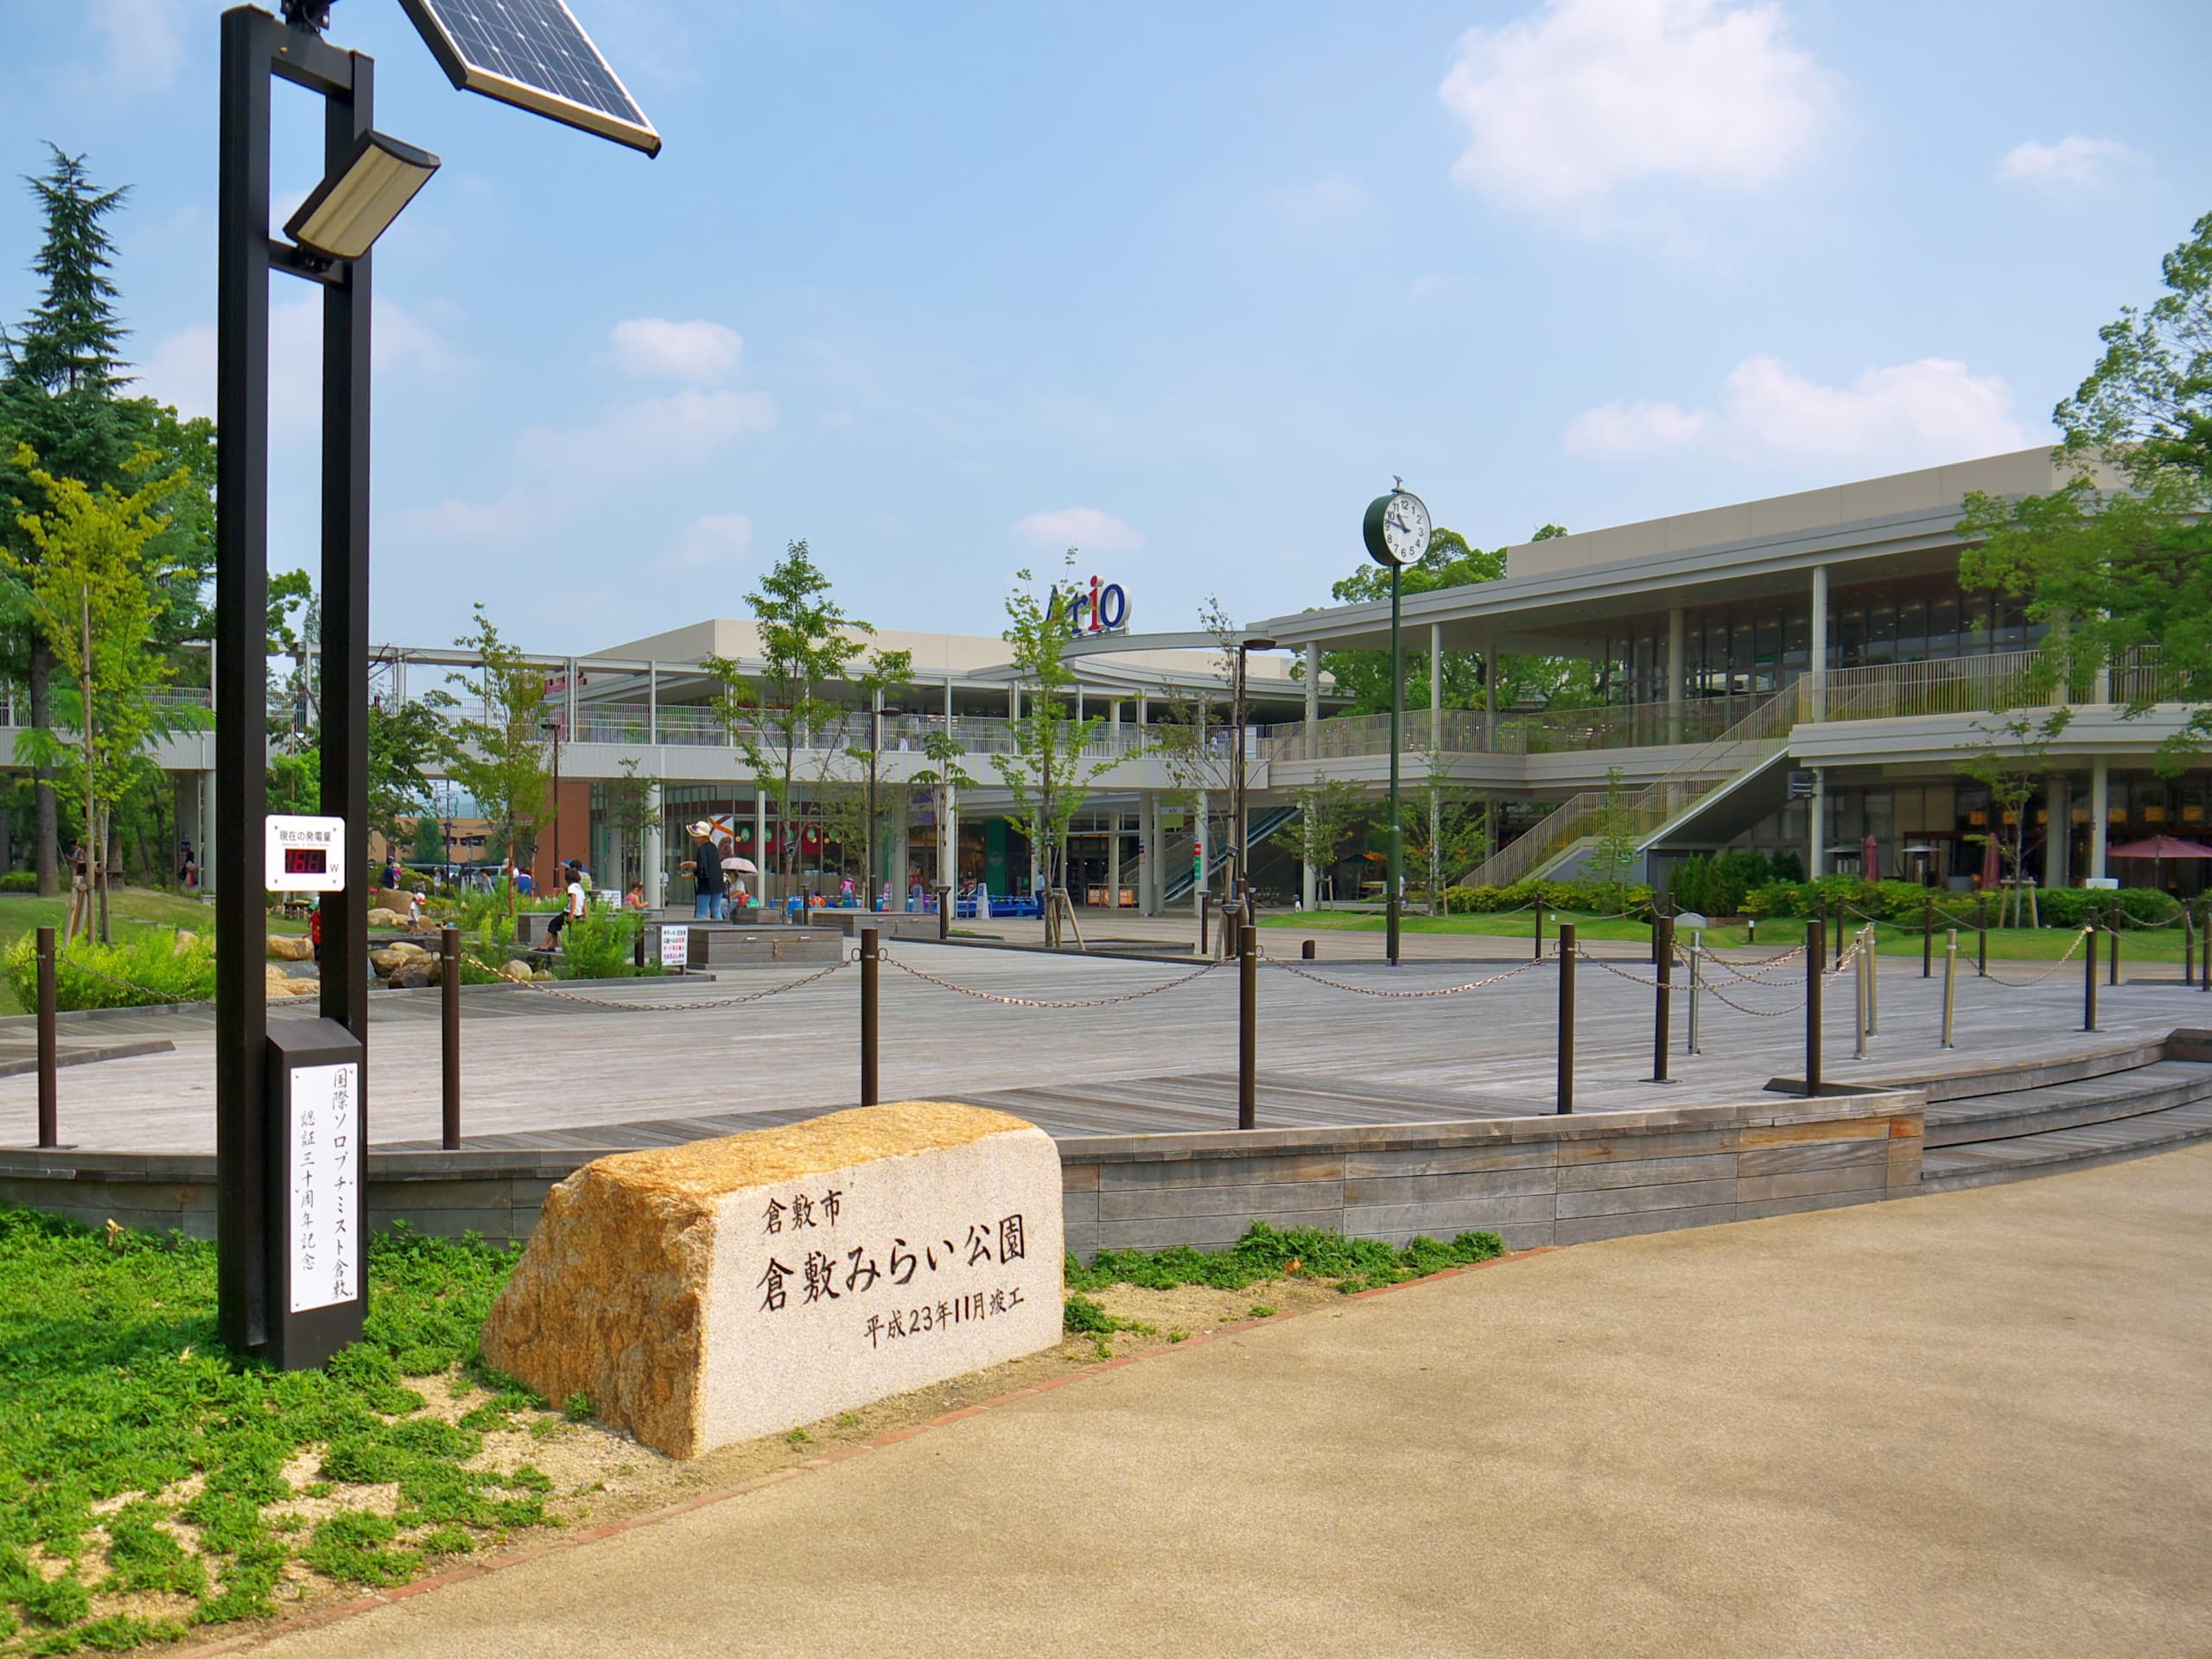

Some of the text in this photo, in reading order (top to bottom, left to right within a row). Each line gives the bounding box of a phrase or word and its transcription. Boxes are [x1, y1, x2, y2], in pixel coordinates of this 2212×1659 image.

[1393, 503, 1400, 512] 11
[1401, 500, 1409, 510] 12
[1387, 511, 1395, 520] 10
[1417, 515, 1422, 524] 2
[1385, 521, 1390, 531] 9
[1418, 527, 1424, 537] 3
[1387, 534, 1392, 543] 8
[1415, 539, 1421, 548] 4
[1394, 543, 1399, 553] 7
[1401, 548, 1406, 557] 6
[1409, 546, 1414, 555] 5
[280, 830, 331, 842] 現在の発電量
[330, 864, 339, 873] W
[333, 1068, 349, 1300] 国際ソロプチミスト倉敷
[300, 1110, 315, 1270] 認証三十周年記念
[762, 1189, 842, 1235] 倉敷市
[756, 1214, 1026, 1313] 倉敷みらい公園
[864, 1287, 1024, 1350] 平成23年11月竣工
